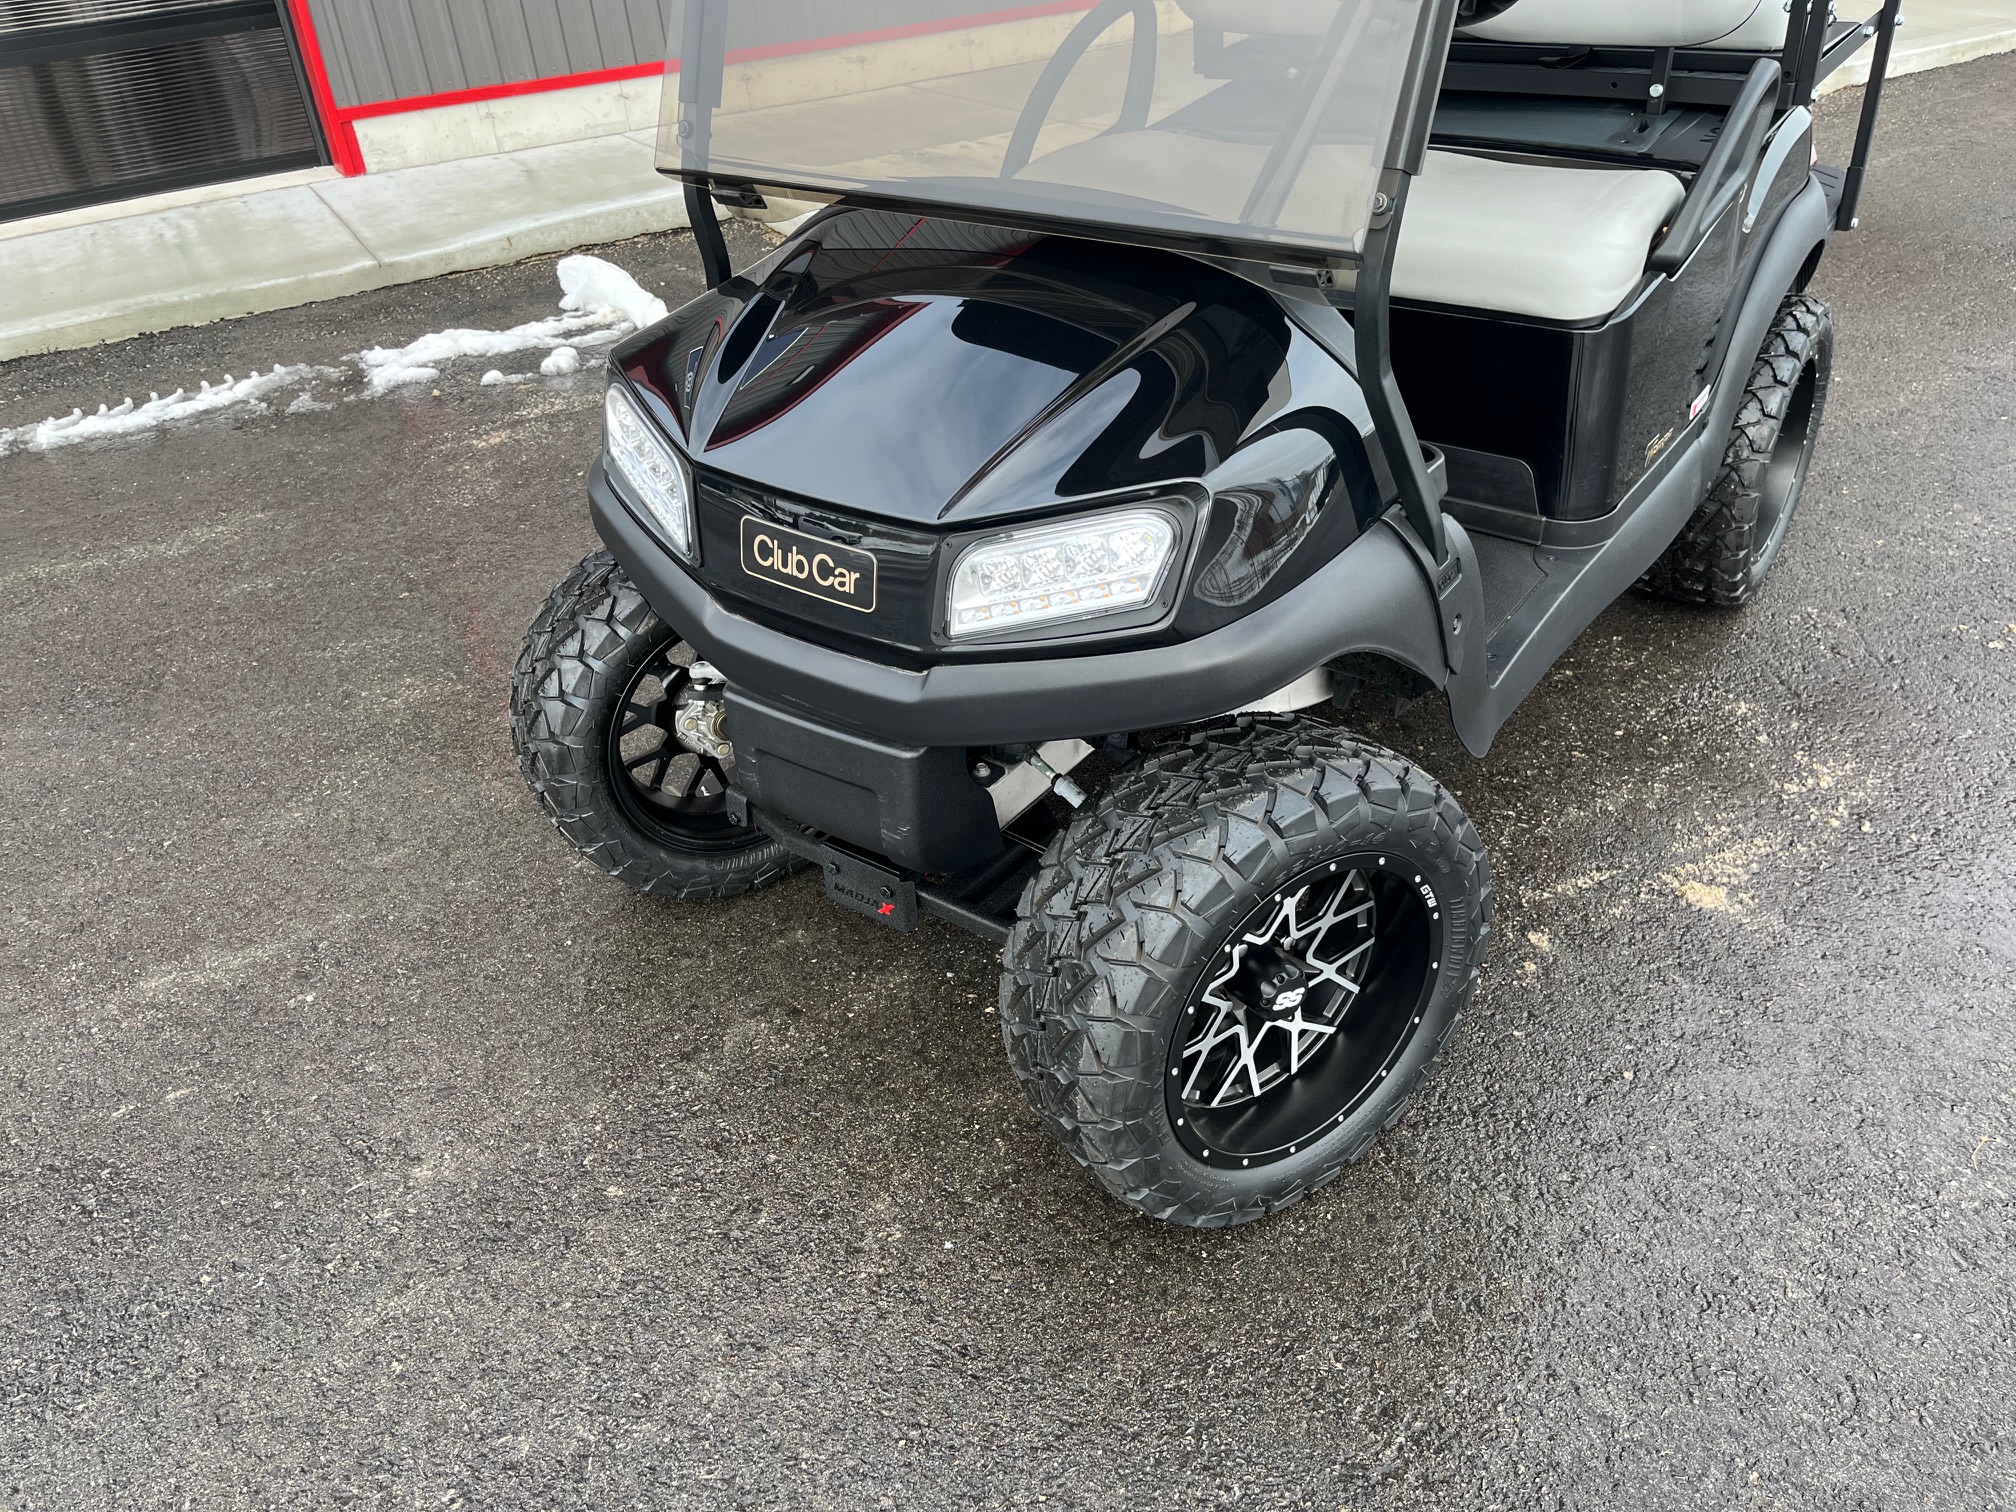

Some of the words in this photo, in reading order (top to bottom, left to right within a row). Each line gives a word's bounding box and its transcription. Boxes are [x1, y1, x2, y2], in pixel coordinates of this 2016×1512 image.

[753, 534, 809, 579] Club
[812, 553, 860, 594] Car
[1420, 884, 1437, 908] GTW
